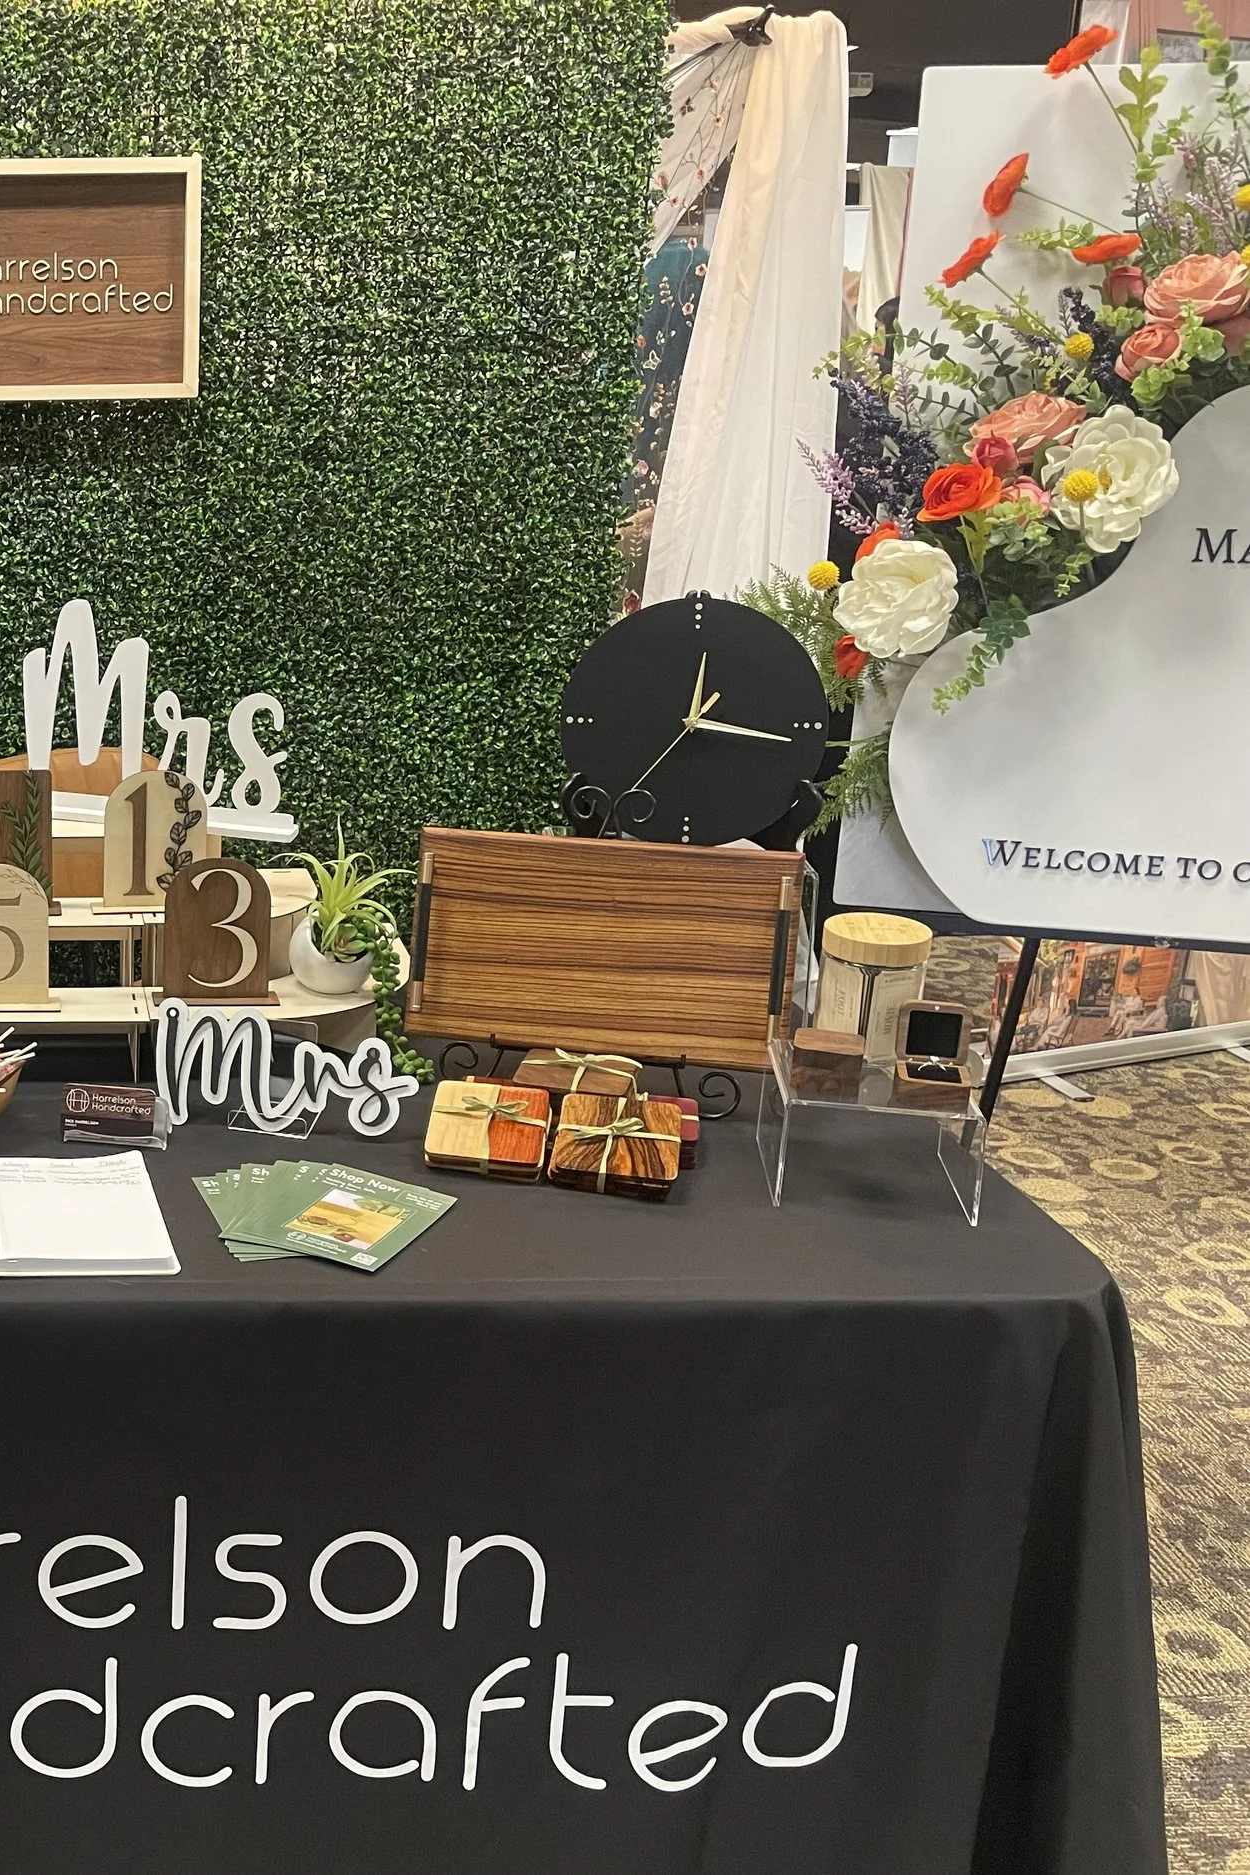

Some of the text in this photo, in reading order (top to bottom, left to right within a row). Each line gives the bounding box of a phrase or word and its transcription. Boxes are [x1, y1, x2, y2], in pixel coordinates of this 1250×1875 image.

[23, 600, 288, 812] Mrs
[123, 782, 155, 897] 1
[982, 838, 1165, 878] WELCOME
[1176, 857, 1223, 881] TO
[187, 868, 260, 988] 3
[156, 997, 420, 1137] Mrs
[92, 1102, 152, 1115] Handcrafted
[93, 1093, 137, 1104] Harrelson
[251, 1167, 270, 1177] Sh
[329, 1168, 365, 1184] Shop
[367, 1179, 401, 1194] Now
